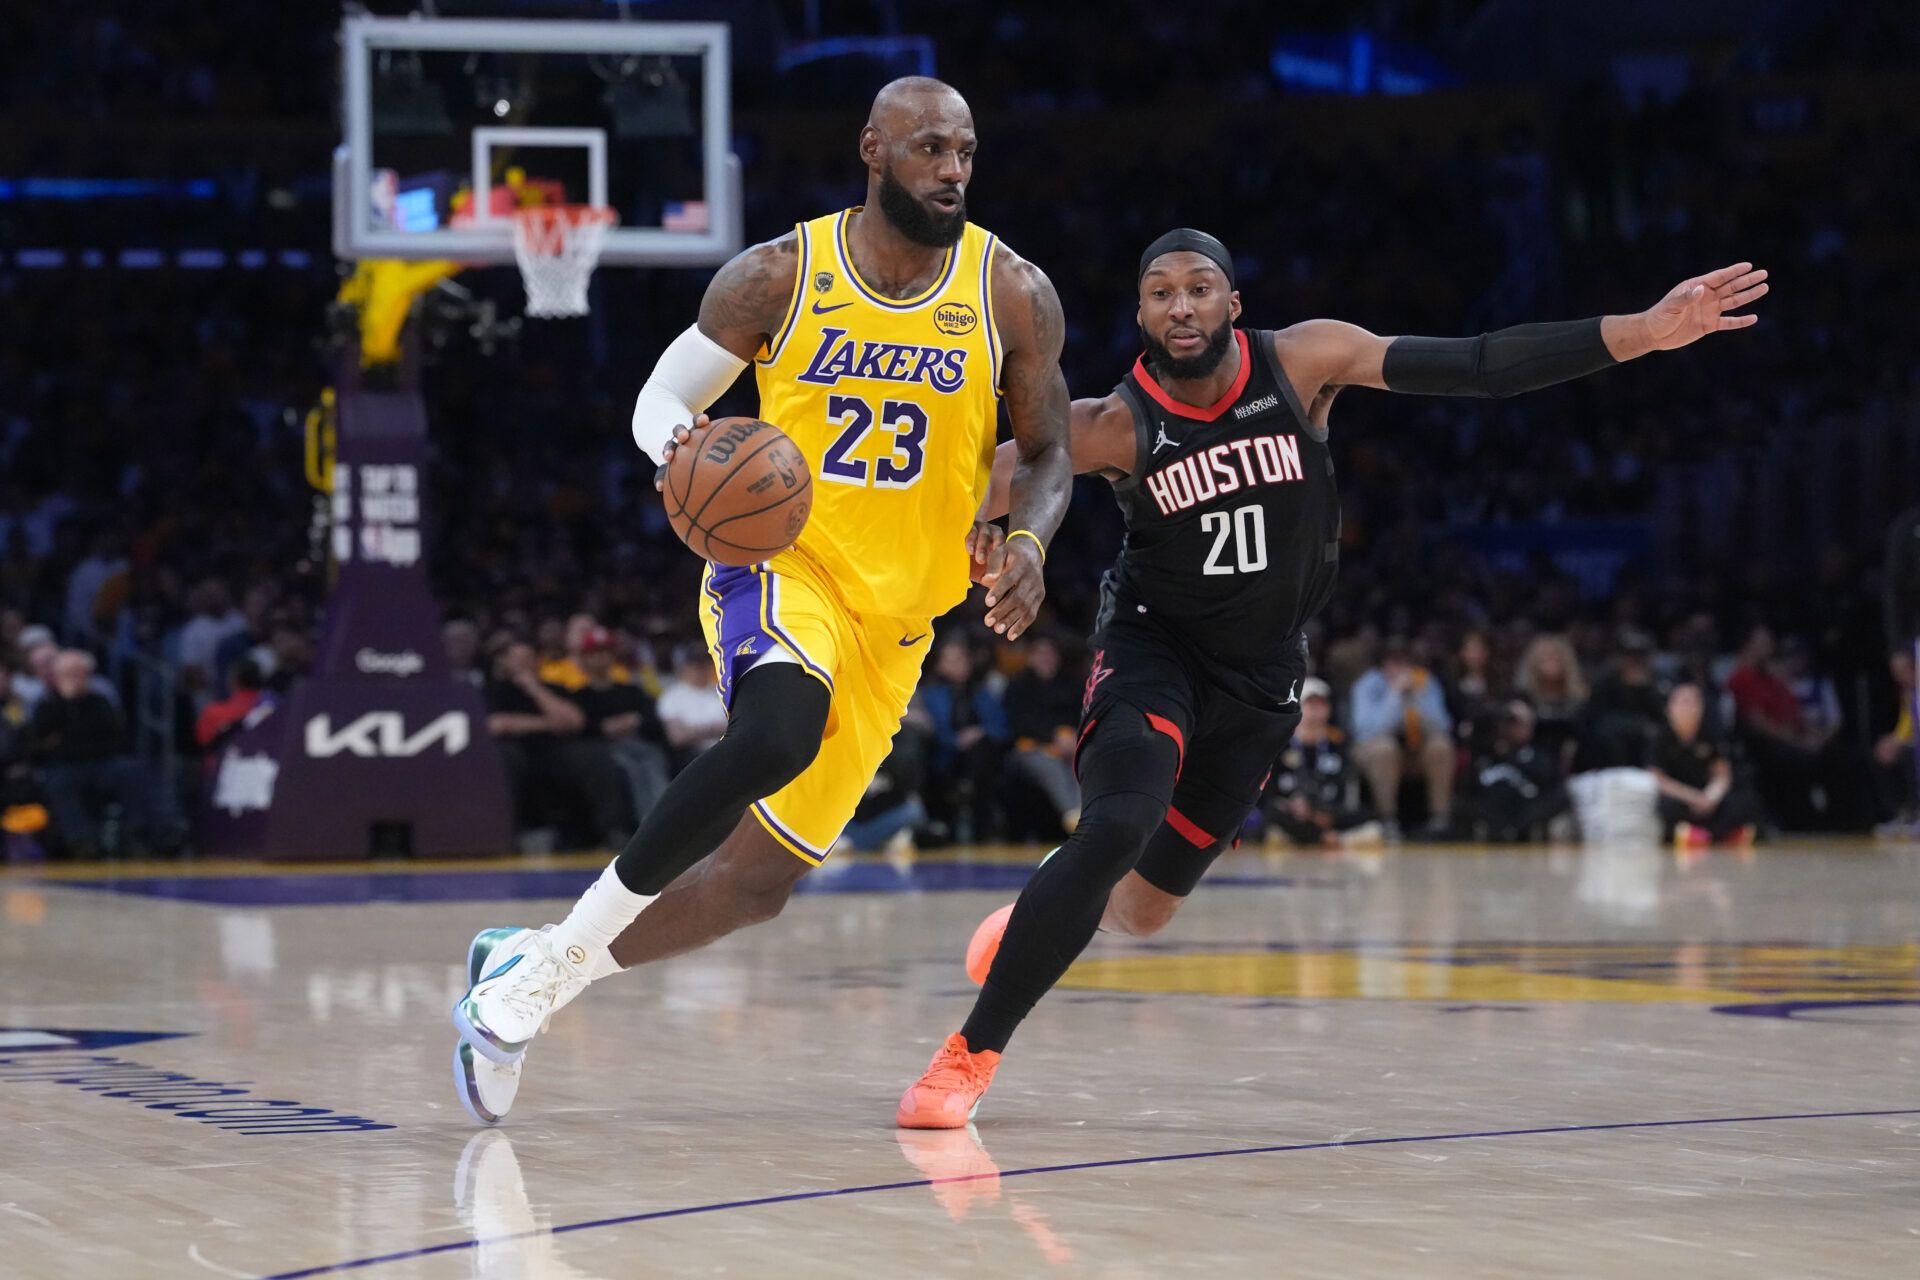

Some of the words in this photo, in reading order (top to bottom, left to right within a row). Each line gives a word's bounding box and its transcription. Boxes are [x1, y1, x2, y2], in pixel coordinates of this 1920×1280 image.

[938, 311, 974, 327] bibigo
[797, 327, 968, 394] LAKERS
[1234, 394, 1277, 414] MEMORIAL
[1236, 398, 1278, 419] HERMANN
[820, 394, 930, 490] 23
[1147, 434, 1304, 516] HOUSTON
[1201, 504, 1268, 576] 20
[356, 647, 426, 678] Google
[305, 711, 469, 757] KIA
